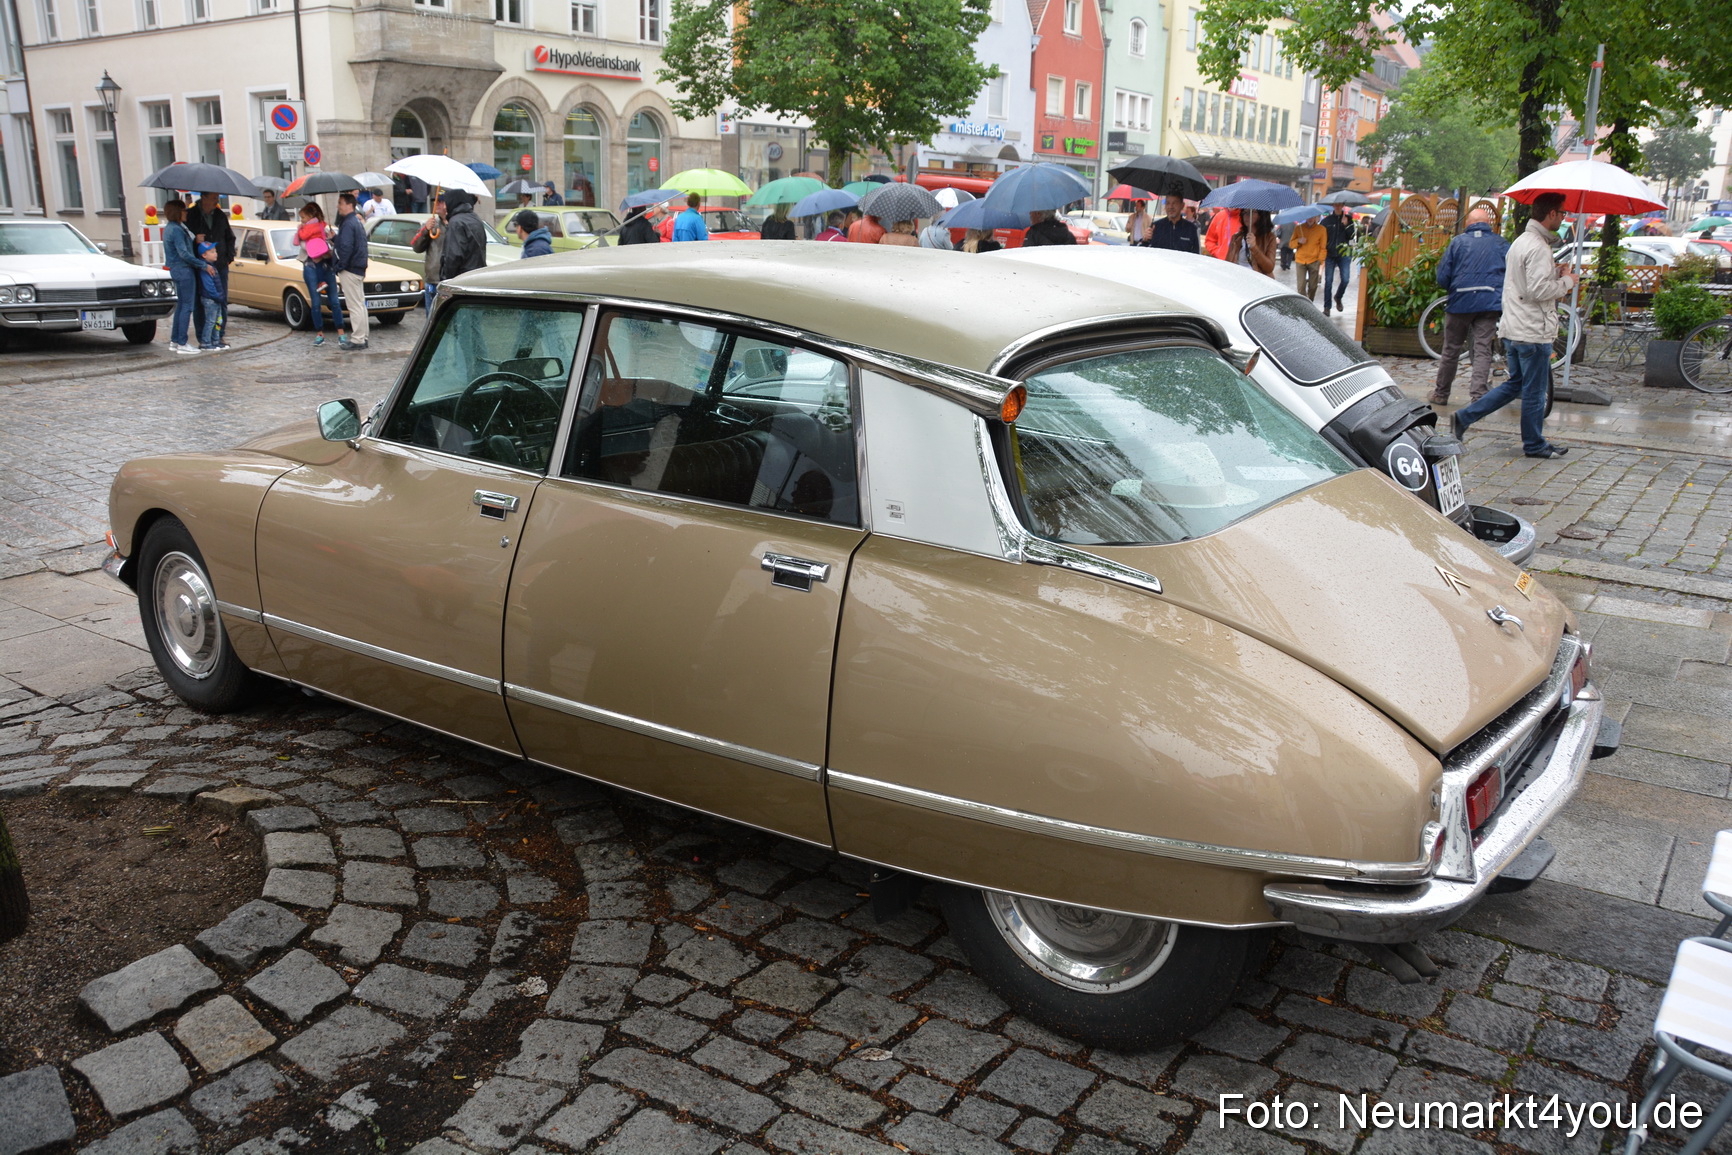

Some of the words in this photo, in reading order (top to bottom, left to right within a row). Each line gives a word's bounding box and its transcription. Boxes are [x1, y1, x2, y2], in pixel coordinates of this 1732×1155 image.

[549, 48, 641, 73] HypoVereinsbank
[275, 132, 296, 140] ZONE
[91, 312, 97, 320] N
[1397, 457, 1424, 476] 64
[1440, 461, 1455, 487] ERH
